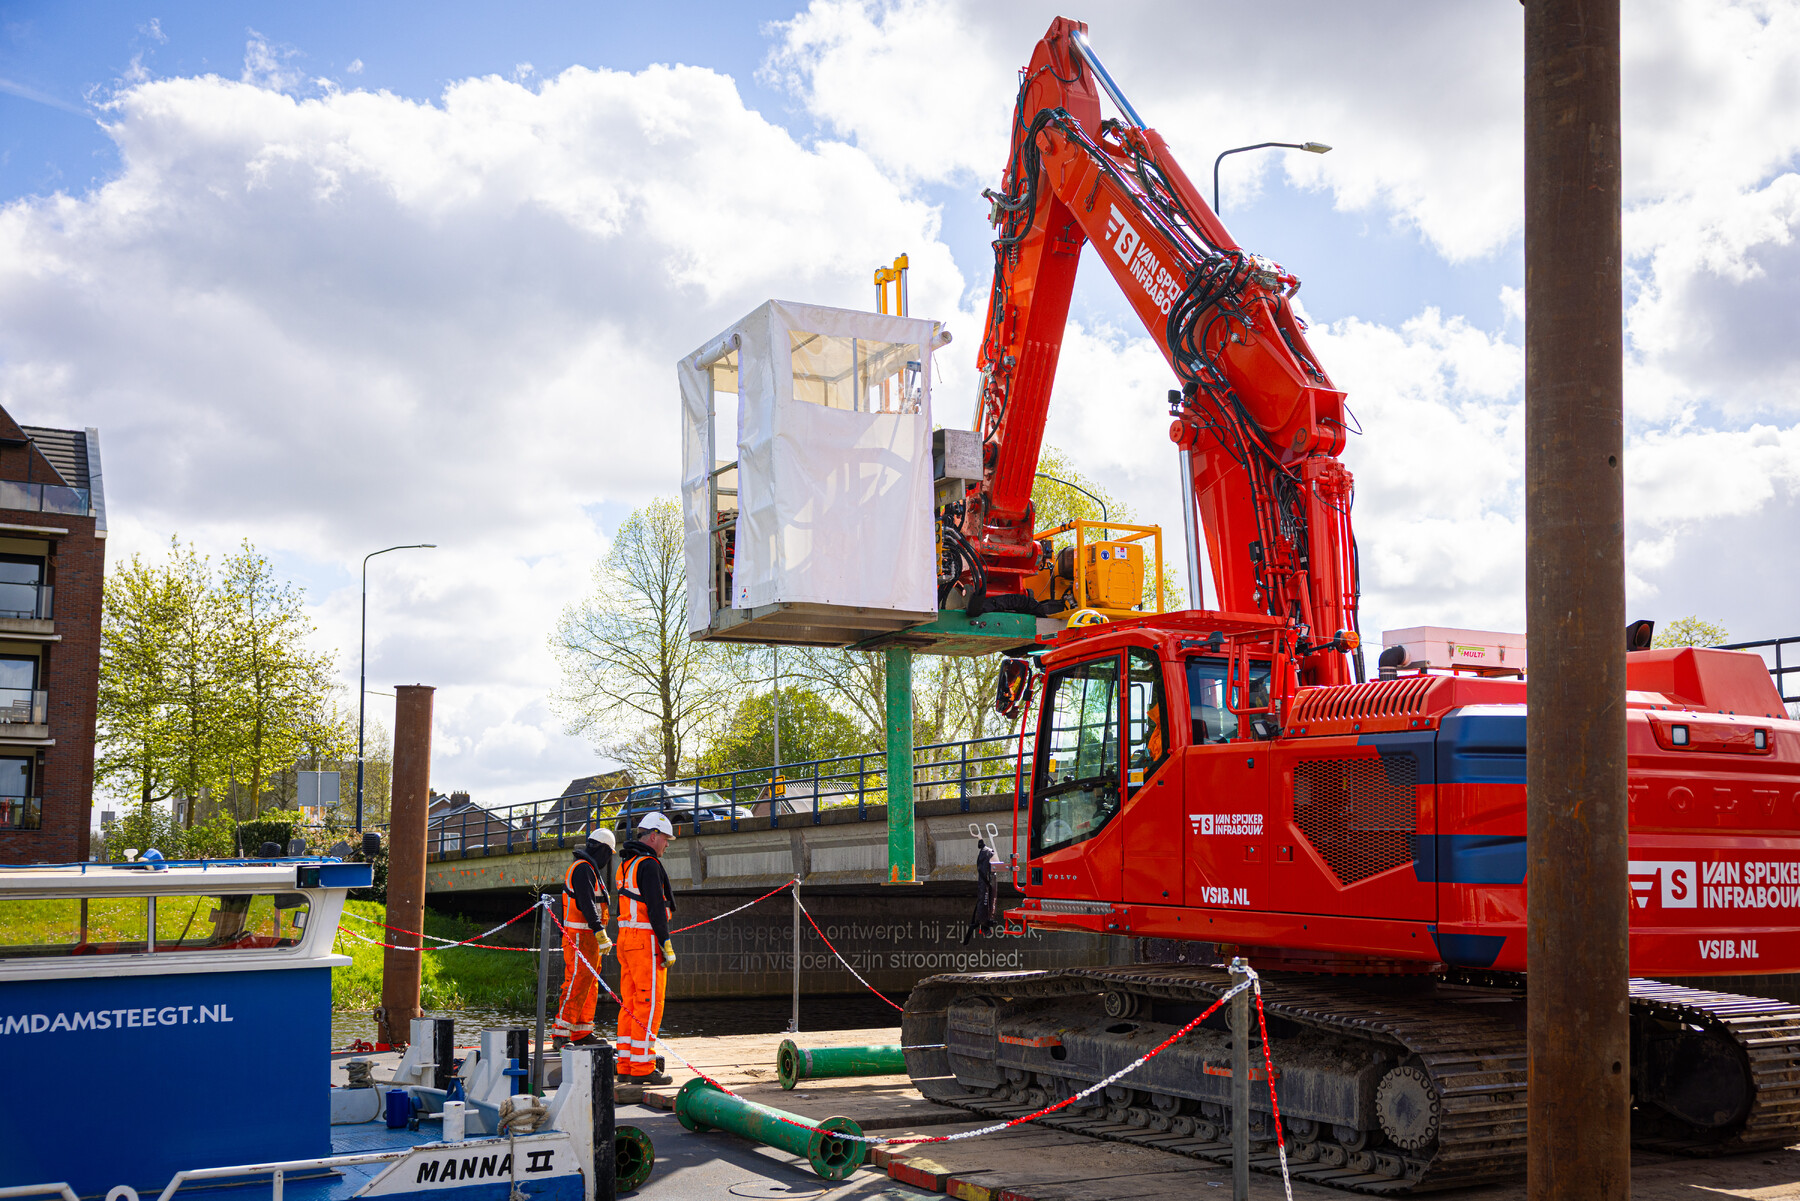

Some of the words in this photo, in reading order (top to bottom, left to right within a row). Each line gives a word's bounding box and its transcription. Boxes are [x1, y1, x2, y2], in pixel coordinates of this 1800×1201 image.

[1136, 241, 1161, 275] VAN
[1129, 258, 1176, 320] INFRABO
[1215, 814, 1231, 825] VAN
[1231, 814, 1263, 825] SPIJKER
[1702, 861, 1740, 884] VAN
[1744, 861, 1800, 884] SPIJKE
[1201, 886, 1250, 905] VSIB.NL
[826, 922, 912, 944] ontwerpt
[920, 921, 940, 943] hij
[1698, 939, 1759, 959] VSIB.NL
[728, 951, 762, 974] zijn
[768, 951, 845, 972] visoen,
[851, 950, 883, 973] zijn
[890, 949, 1024, 972] stroomgebied;
[0, 1003, 234, 1035] MDAMSTEEGT.NL
[416, 1153, 514, 1184] MANNA
[525, 1149, 555, 1172] II
